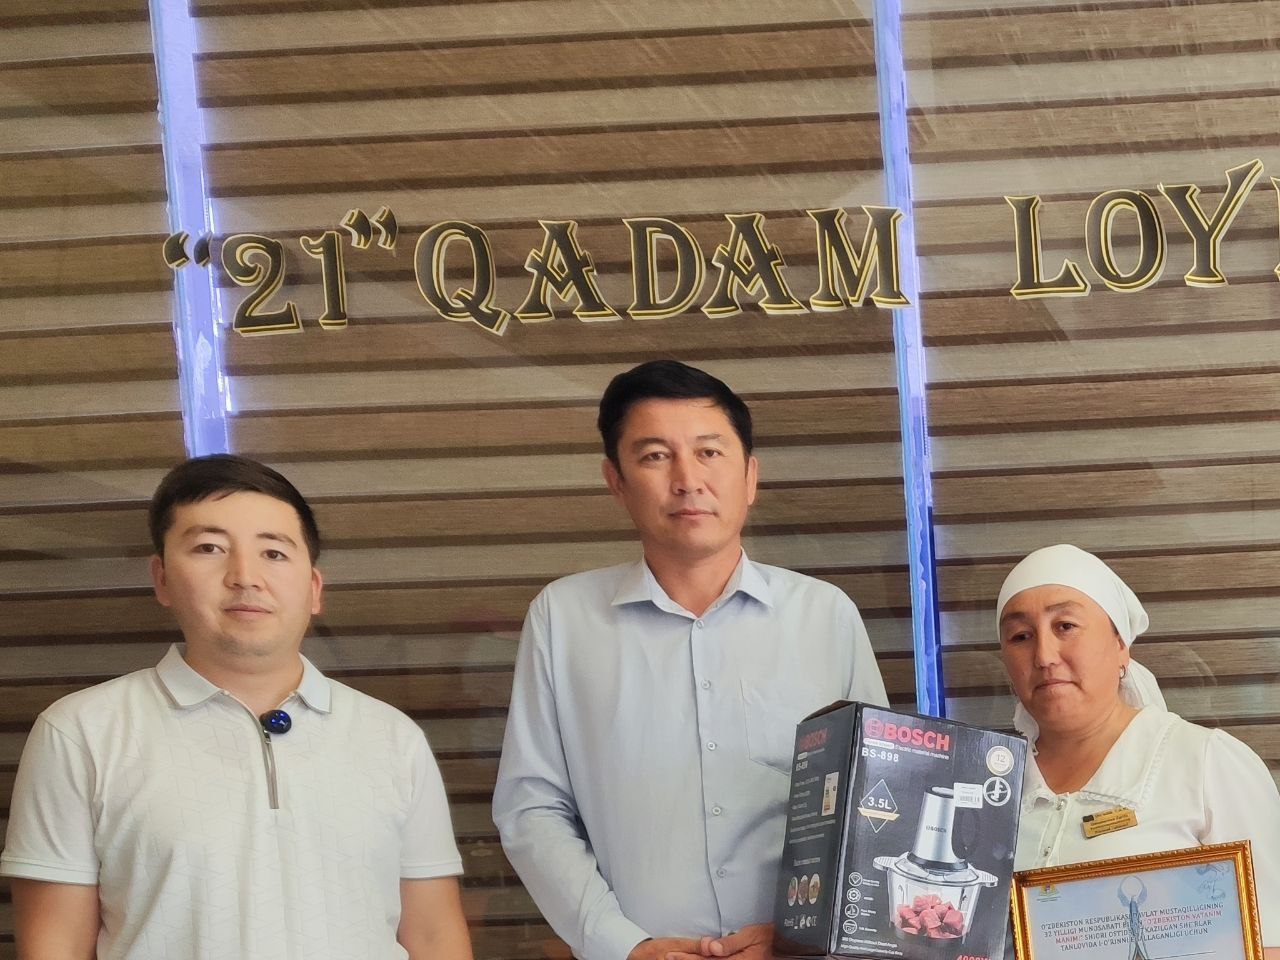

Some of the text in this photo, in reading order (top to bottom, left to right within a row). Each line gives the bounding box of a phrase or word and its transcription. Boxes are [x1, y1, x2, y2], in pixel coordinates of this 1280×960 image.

[413, 203, 912, 337] QADAM
[884, 722, 950, 751] BOSCH
[861, 747, 899, 763] BS-898
[867, 796, 892, 810] 3.5L
[1044, 930, 1052, 938] 32
